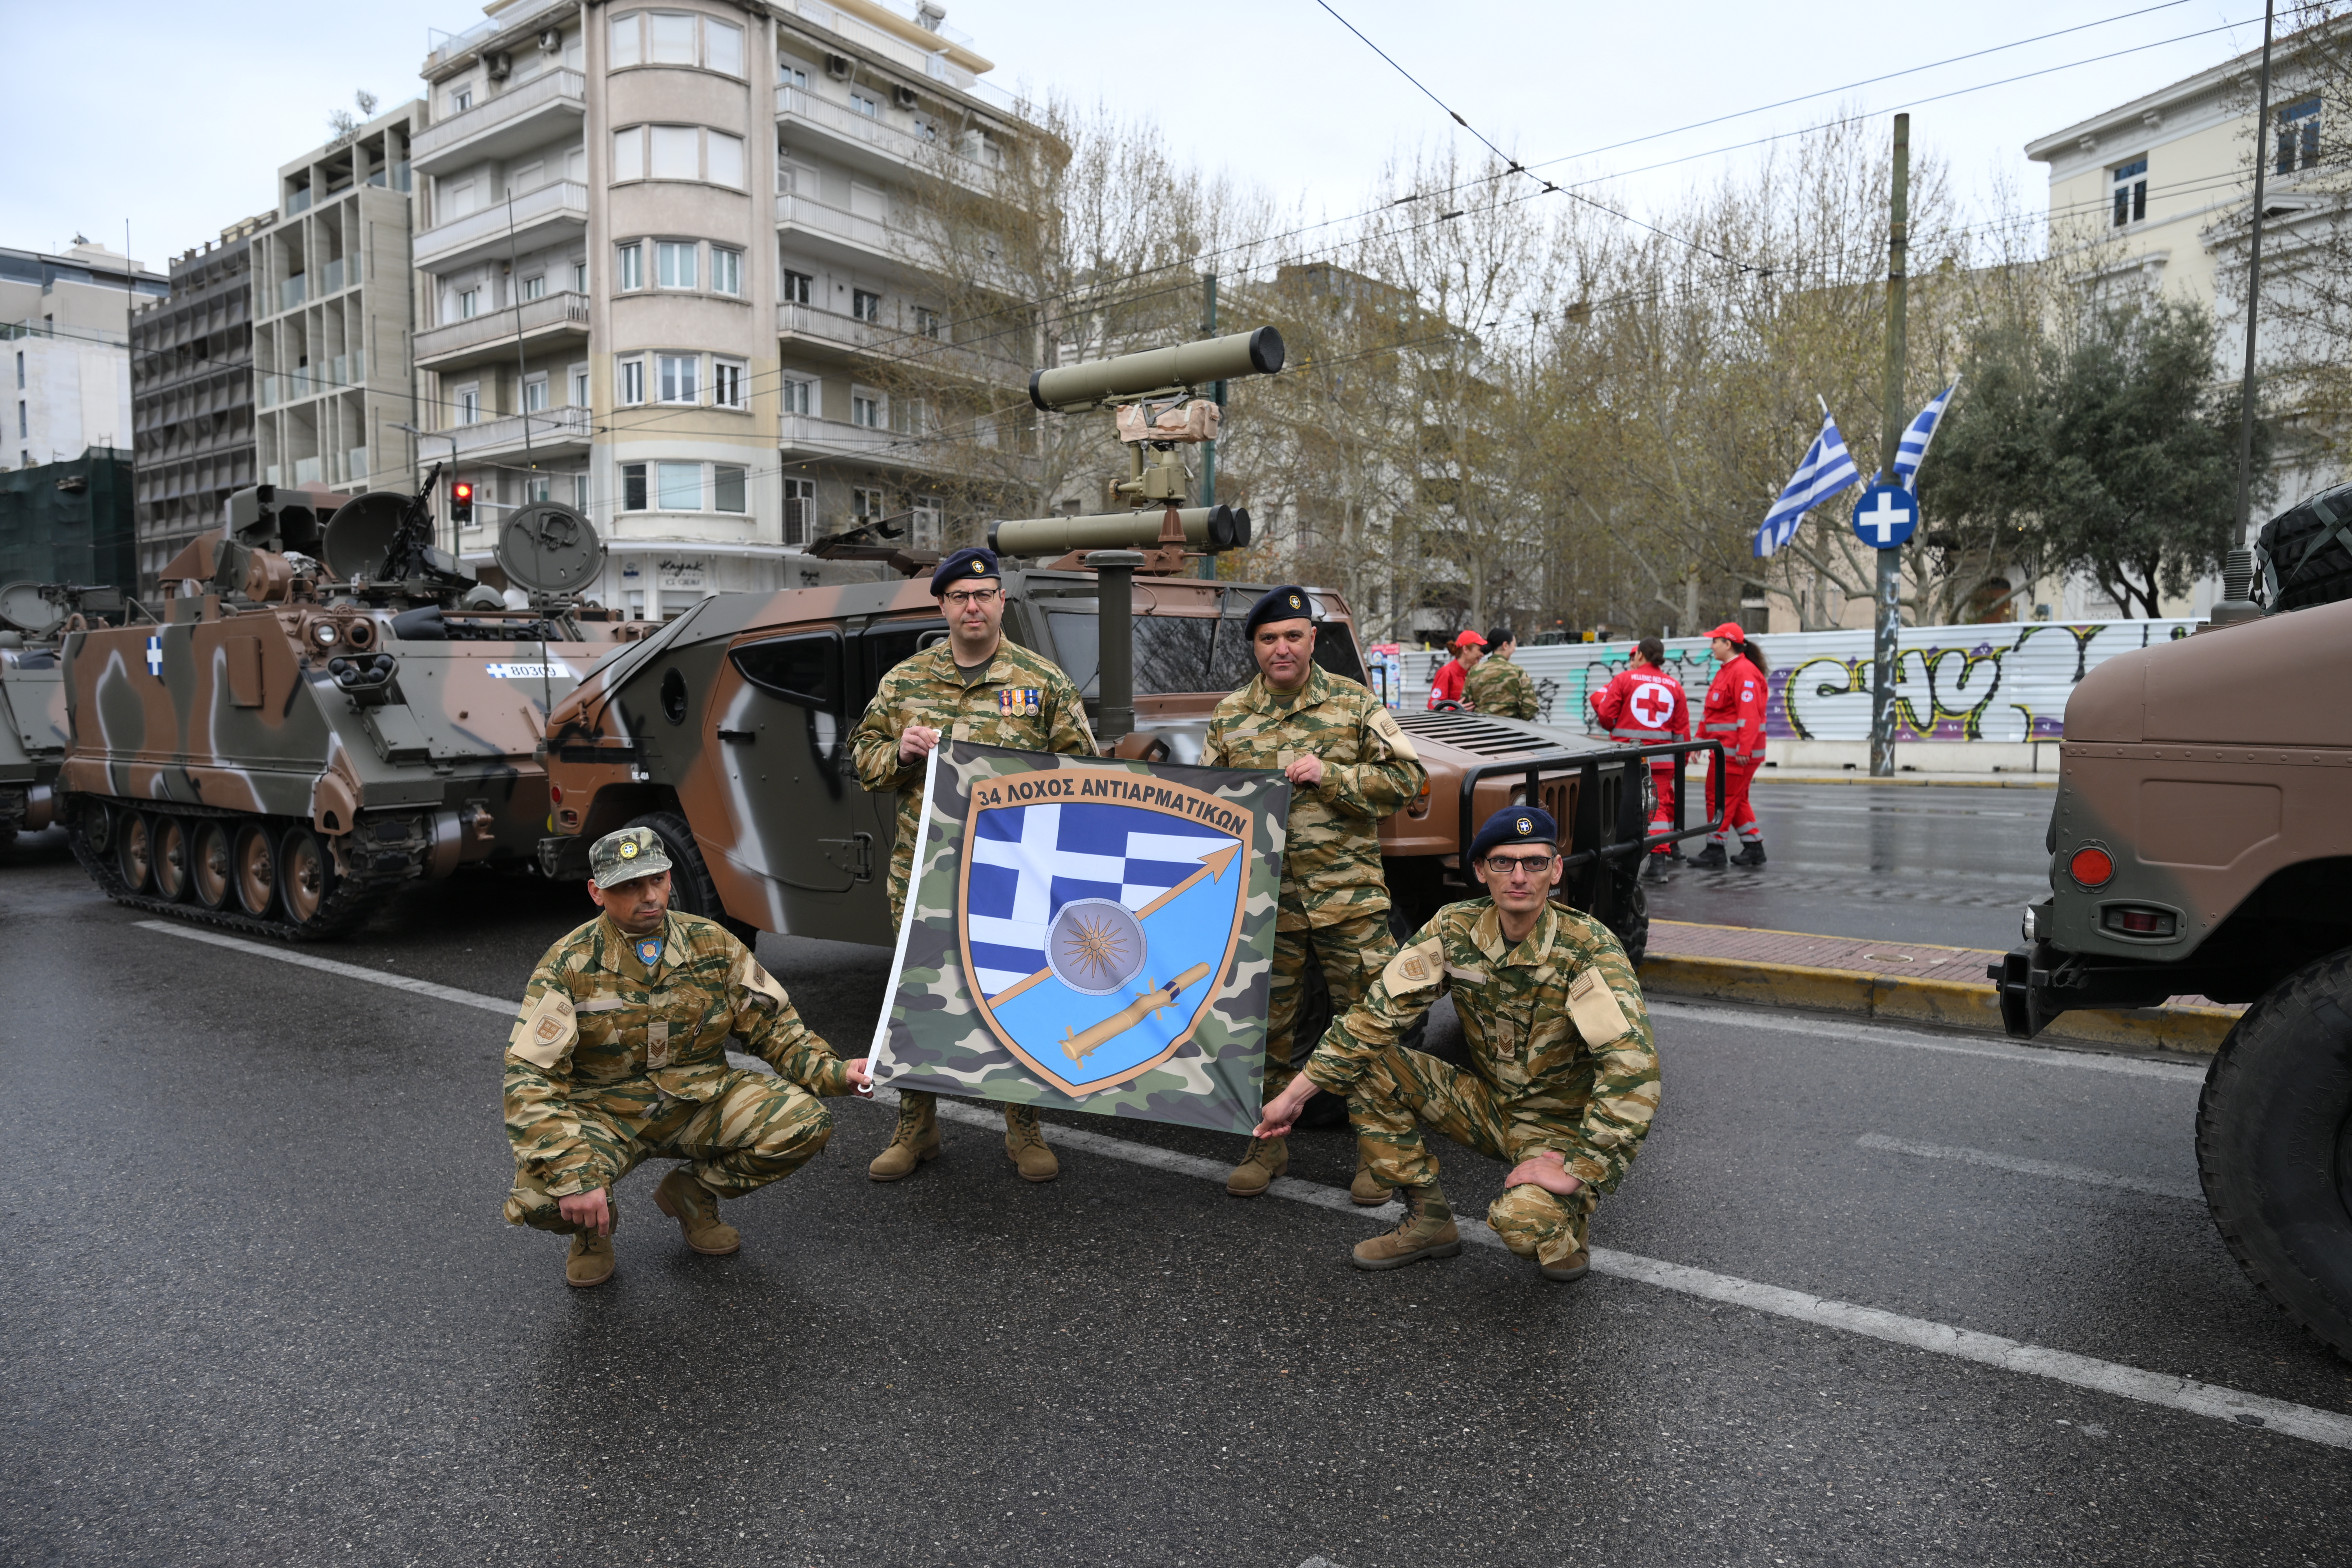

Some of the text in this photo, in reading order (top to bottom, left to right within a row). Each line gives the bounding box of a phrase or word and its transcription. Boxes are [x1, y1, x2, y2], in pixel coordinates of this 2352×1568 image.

[510, 666, 556, 677] 80309
[977, 778, 1247, 836] 34 ΛΟΧΟΣ ΑΝΤΙΑΡΜΑΤΙΚΩΝ
[1549, 888, 1560, 896] DOWN
